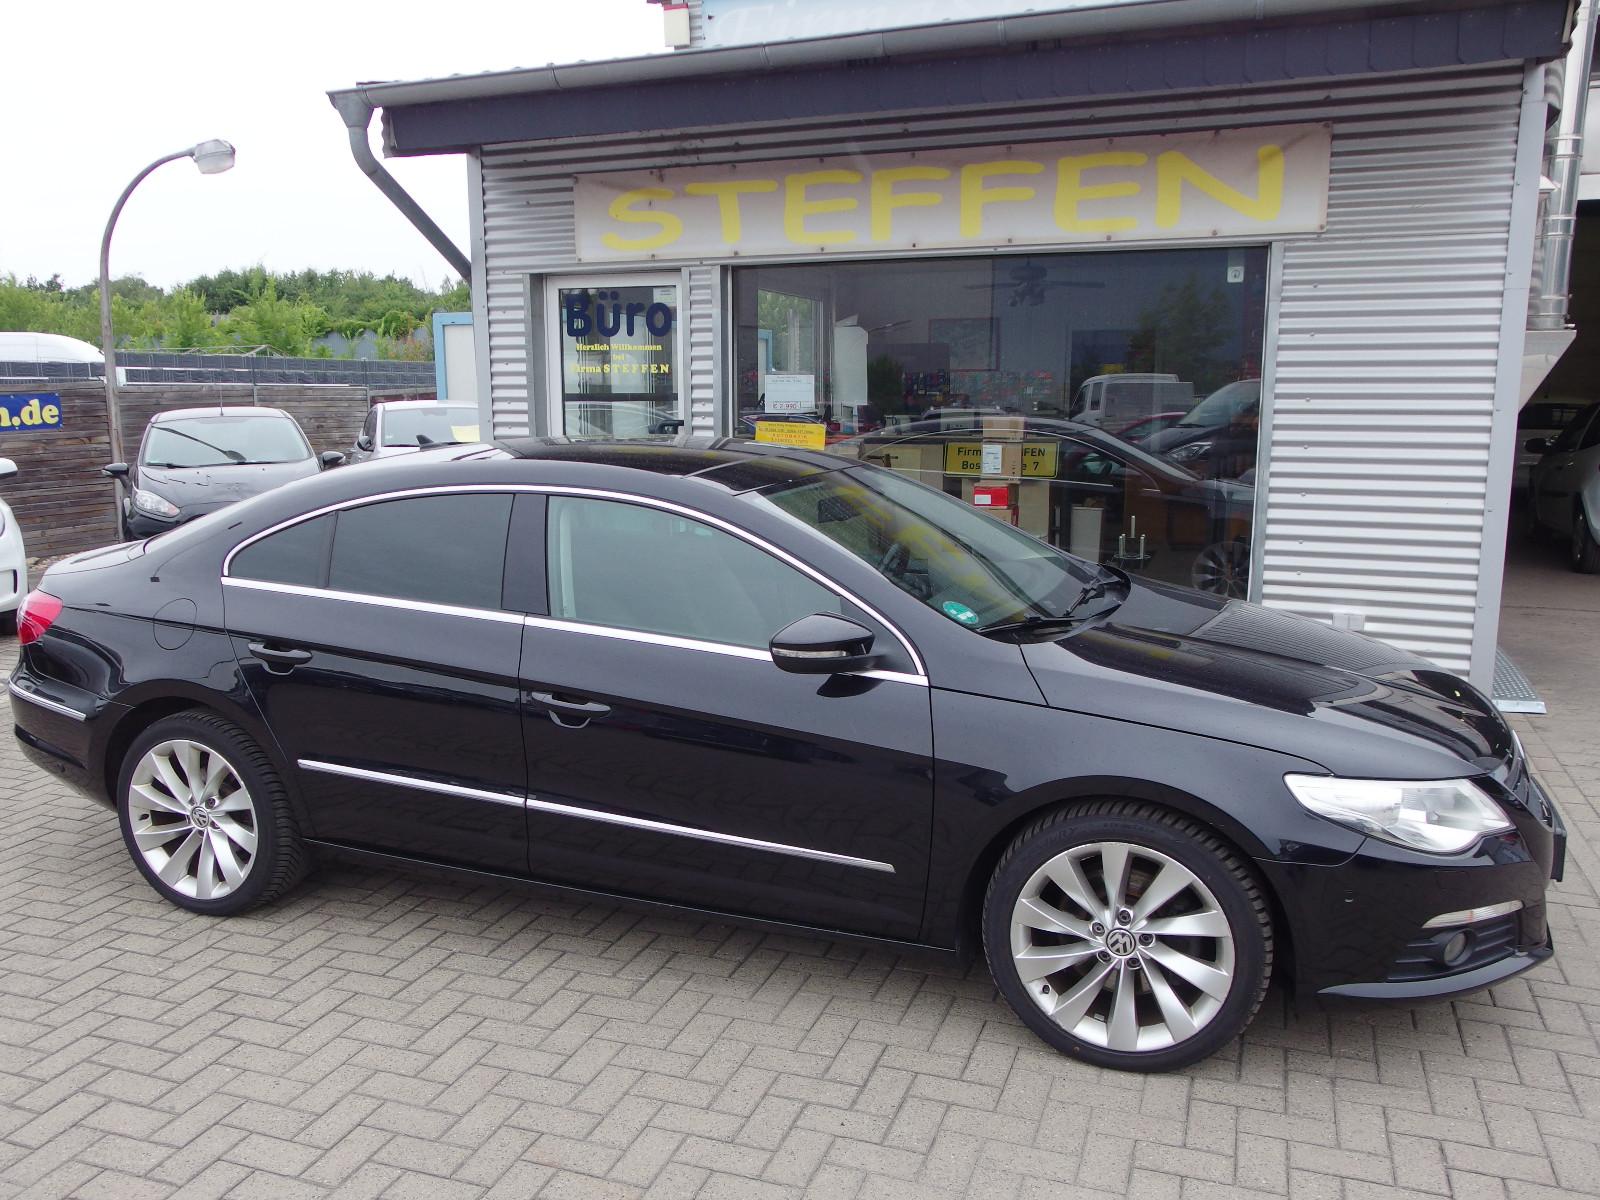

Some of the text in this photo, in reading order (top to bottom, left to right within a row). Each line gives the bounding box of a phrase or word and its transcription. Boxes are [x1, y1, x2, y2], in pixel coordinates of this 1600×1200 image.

[600, 144, 1285, 251] STEFFEN
[565, 290, 673, 338] Büro
[603, 363, 669, 374] STEFFEN
[0, 398, 59, 427] n.de
[957, 447, 1046, 456] Firm FEN
[961, 460, 981, 470] Bos
[1033, 461, 1040, 471] 7
